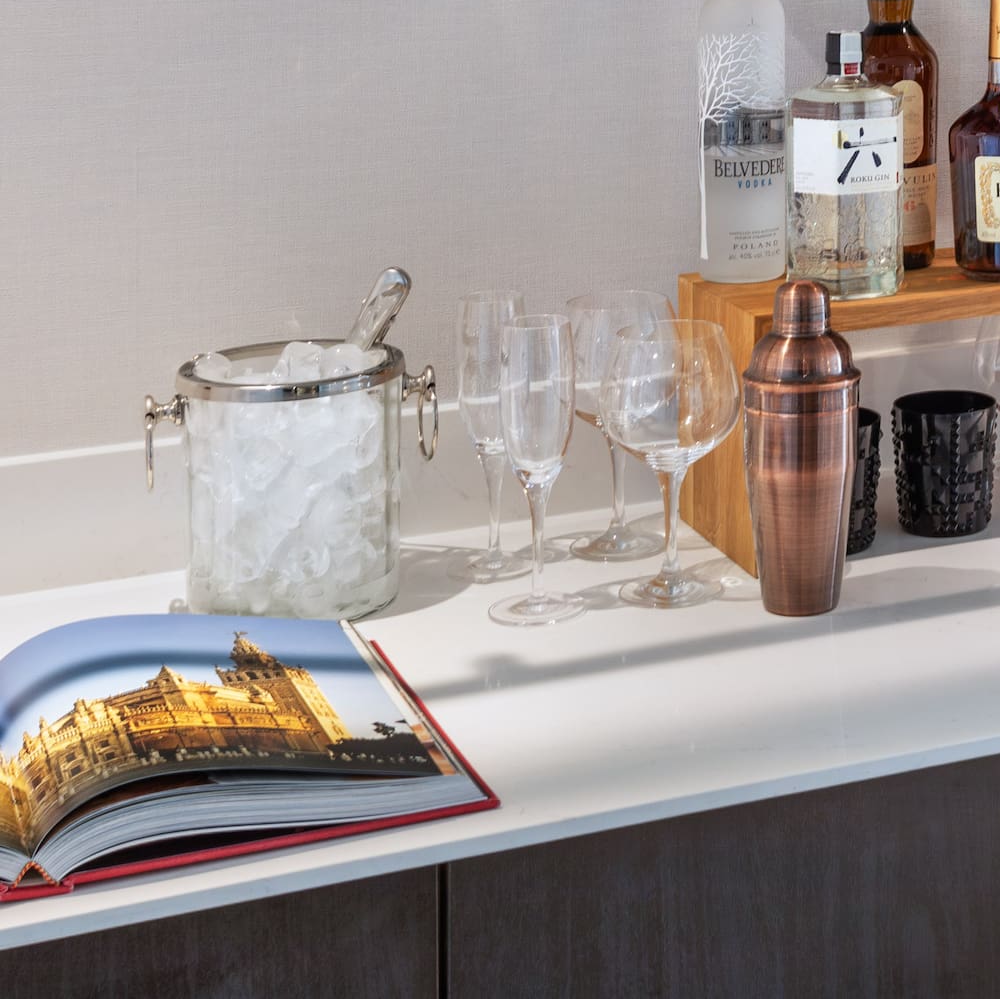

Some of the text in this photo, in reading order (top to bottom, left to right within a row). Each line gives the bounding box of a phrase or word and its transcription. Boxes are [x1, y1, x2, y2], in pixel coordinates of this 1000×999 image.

[737, 178, 773, 189] VODKA
[850, 173, 890, 184] ROKU GIN
[733, 239, 778, 250] POLAND
